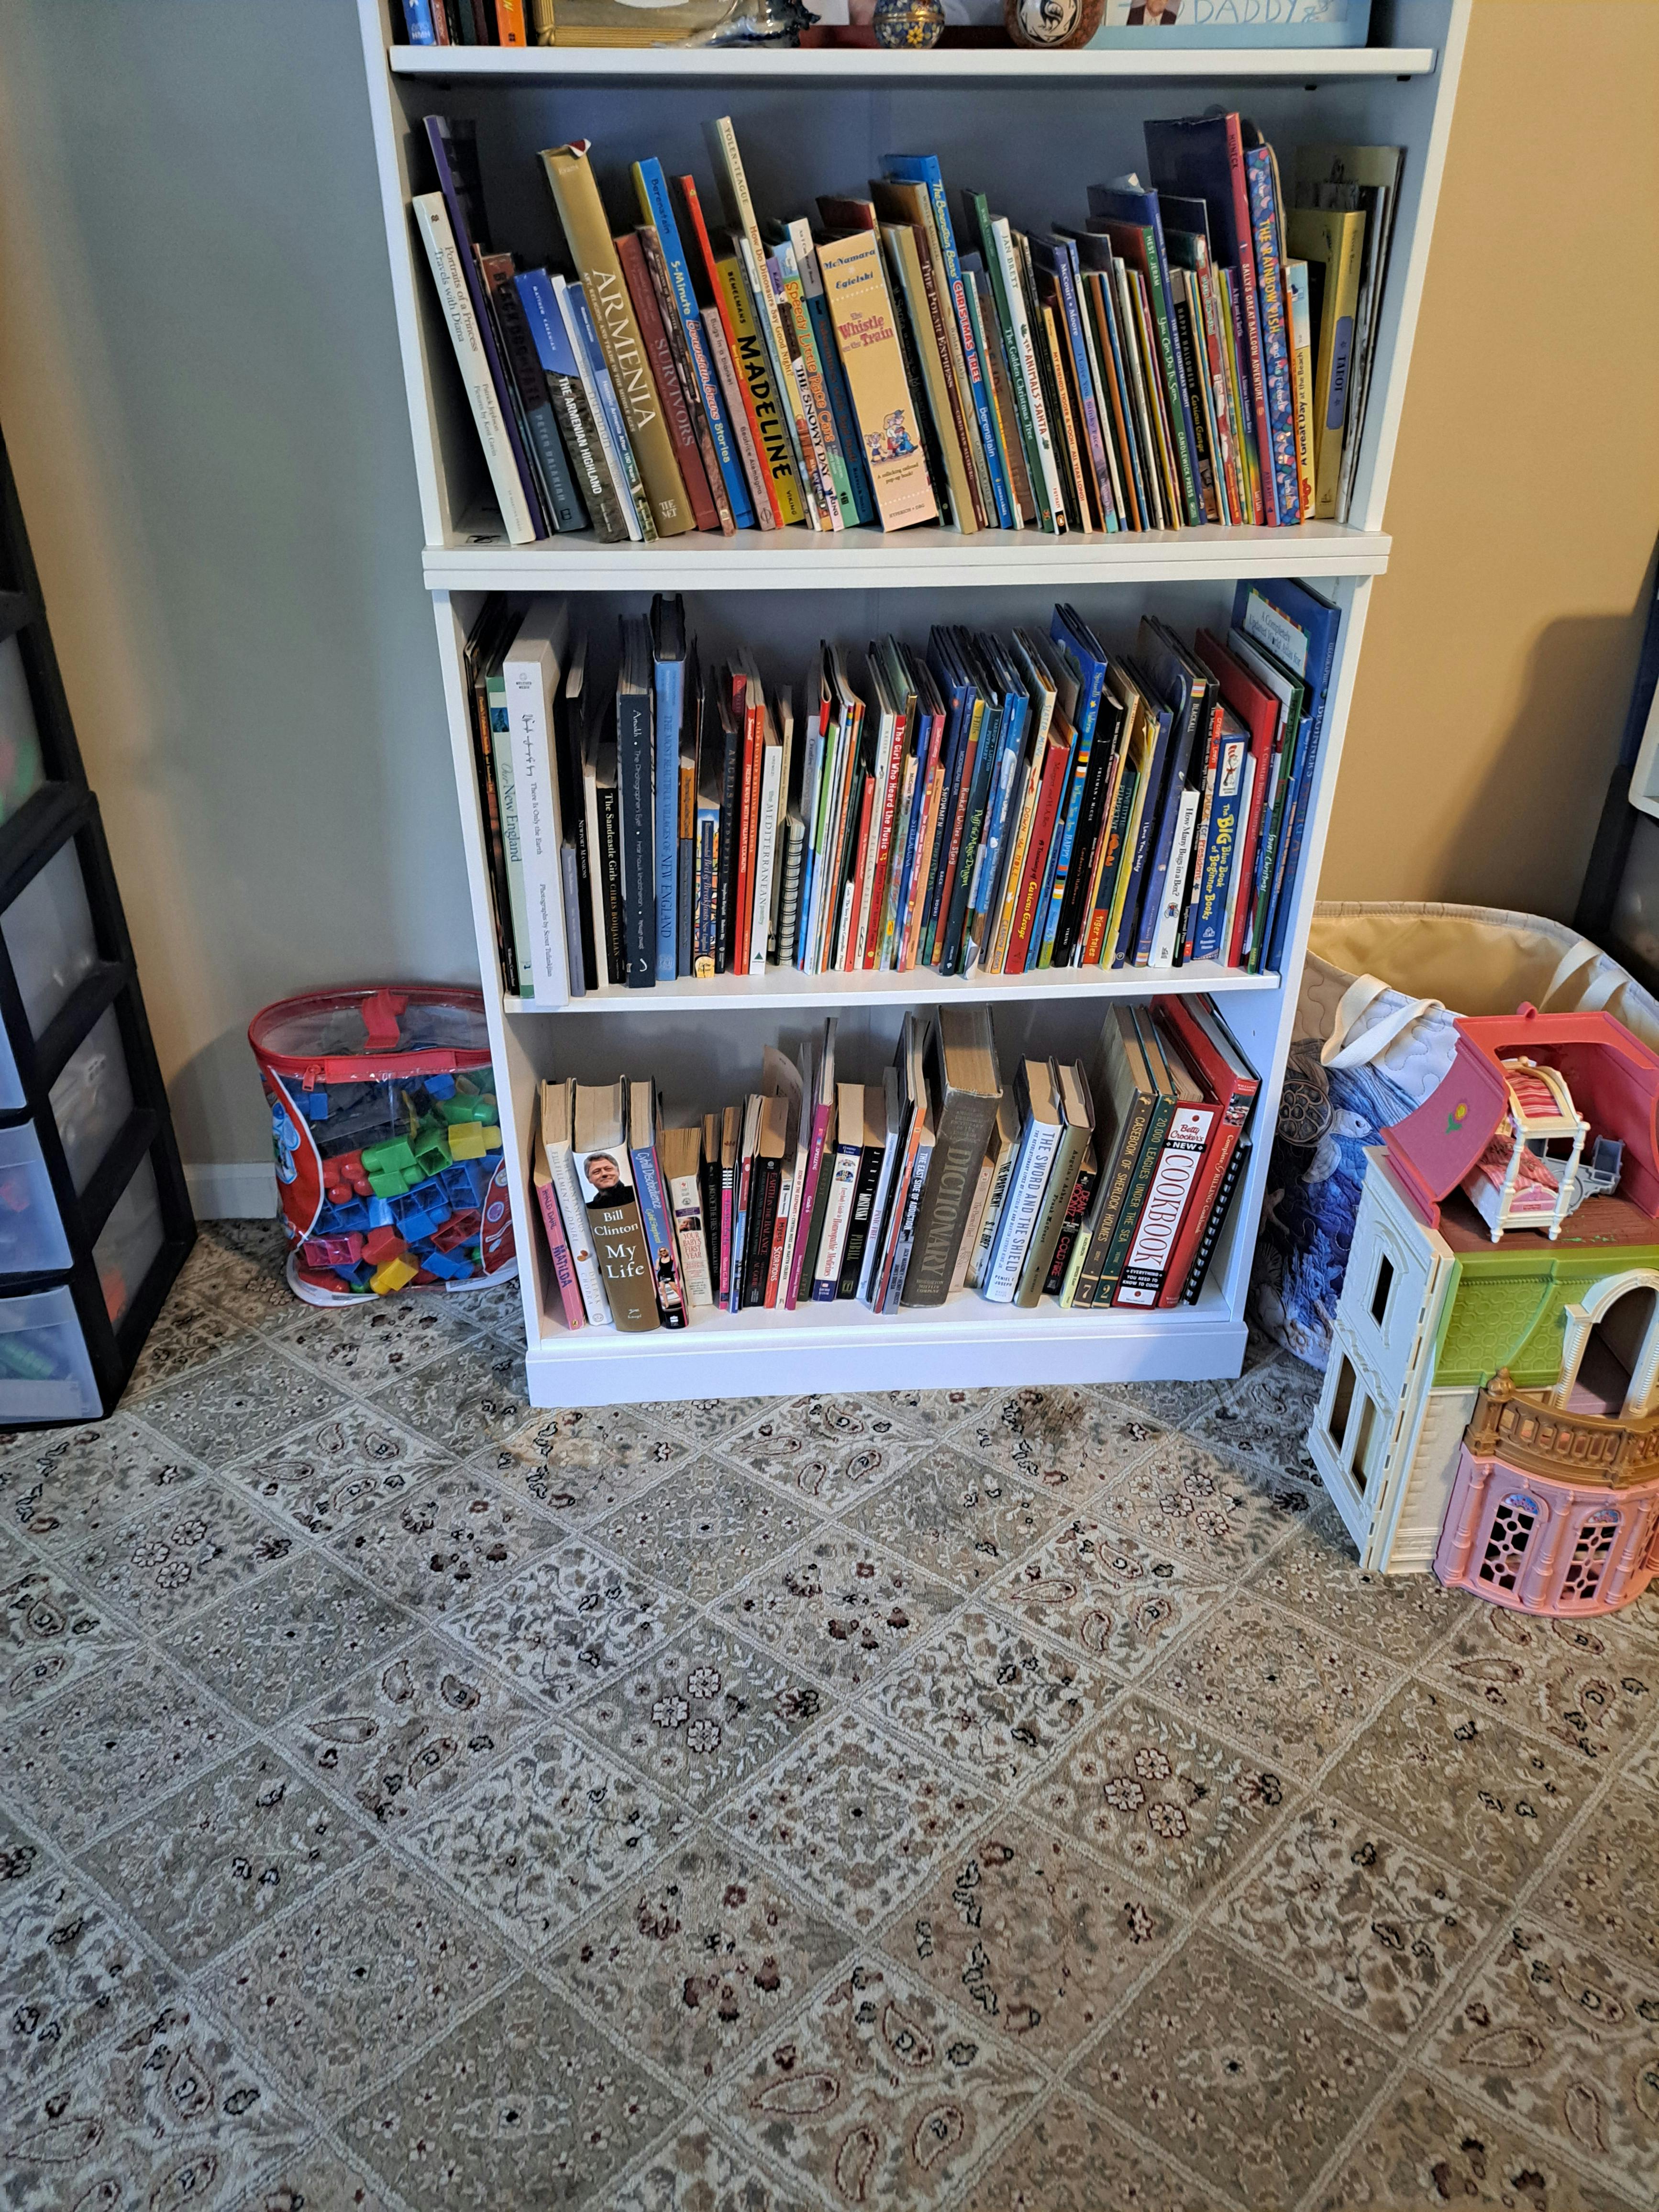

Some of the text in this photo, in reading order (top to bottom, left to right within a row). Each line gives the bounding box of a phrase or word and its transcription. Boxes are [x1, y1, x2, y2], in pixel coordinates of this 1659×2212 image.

[724, 127, 749, 205] YOLEN TEAGUE
[748, 225, 761, 246] How
[754, 248, 765, 263] Do
[822, 249, 876, 270] McNamara
[1002, 234, 1018, 289] JAN BRETT
[1145, 235, 1160, 287] HEST JERAM
[433, 247, 466, 343] Travels with Diana
[443, 245, 463, 289] Portraits
[456, 290, 467, 303] of
[462, 311, 480, 353] Princess
[726, 270, 747, 325] BEMELMANS
[758, 263, 776, 308] Dinosaurs
[834, 271, 875, 290] Egielski
[931, 179, 982, 384] The Berenstain Bears' CHRISTMAS TREE
[1060, 263, 1079, 336] McCourt Moore
[769, 308, 781, 324] Say
[784, 280, 809, 332] Speedy
[921, 260, 954, 388] THE POLAR EXPRESS
[1257, 219, 1287, 412] THE RAINBOW FISH and His Friends
[590, 262, 659, 433] ARMENIA
[774, 325, 786, 349] Good
[837, 313, 886, 341] Whistle
[859, 326, 895, 348] Train
[669, 259, 732, 464] 5-Minute Berenstain Bears Stories
[779, 351, 793, 378] Night?
[797, 332, 818, 373] Little
[1334, 354, 1347, 392] TAROT
[558, 376, 572, 396] THE
[654, 337, 695, 447] SURVIVORS
[807, 372, 828, 409] Race
[1004, 326, 1034, 441] The Golden Christmas Tree
[563, 395, 588, 448] ARMENIAN
[736, 332, 793, 482] MADELINE
[795, 365, 830, 479] THE SNOWY DAY
[817, 409, 836, 443] Cars
[978, 406, 996, 458] Berenstain
[579, 447, 602, 496] HIGHLAND
[1176, 431, 1194, 498] CANDLEWICK PRESS
[881, 726, 905, 849] The Girl Who Heard the Music
[958, 787, 969, 811] Rocket
[499, 761, 521, 863] Our New England
[954, 815, 964, 837] Writes
[1183, 807, 1193, 826] How
[759, 803, 774, 905] MEDITERRANEAN
[948, 846, 959, 865] Story
[1174, 847, 1186, 866] Bugs
[1178, 826, 1190, 848] Many
[1213, 803, 1235, 888] The BIG Blue Book
[603, 793, 620, 956] The Sandcastle Girls CHRIS BOHJALIAN
[1171, 879, 1181, 896] Box?
[1201, 845, 1220, 921] of Beginner Books
[1087, 914, 1104, 958] tiger tales
[918, 1152, 928, 1164] THE
[1171, 1140, 1196, 1151] NEW
[634, 1151, 662, 1210] Cybill Disobedience
[911, 1179, 922, 1193] SIDE
[914, 1164, 925, 1178] EAST
[997, 1160, 1011, 1174] THE
[1096, 1114, 1146, 1243] CASEBOOK OF SHERLOCK HOLMES
[1117, 1116, 1168, 1244] 20,000 LEAGUES UNDER THE SEA
[1194, 1132, 1235, 1236] Complete GRILLING Cookbook
[919, 1144, 973, 1278] DICTIONARY
[989, 1172, 1009, 1209] APARTMENT
[1004, 1130, 1055, 1274] THE SWORD AND THE SHIELD
[1075, 1190, 1091, 1215] DEAN
[1132, 1150, 1196, 1271] COOKBOOK
[594, 1222, 639, 1236] Clinton
[603, 1209, 623, 1222] Bill
[903, 1200, 918, 1230] ADDICTION
[605, 1243, 636, 1259] My
[770, 1221, 785, 1282] Myers SCORPIONS
[846, 1233, 864, 1261] PINBALL
[978, 1234, 991, 1250] GREY
[1051, 1235, 1071, 1277] COLD FIRE
[606, 1261, 645, 1278] Life
[1130, 1269, 1159, 1278] EVERYTHING
[1079, 1283, 1093, 1301] 7
[1098, 1283, 1110, 1299] 2
